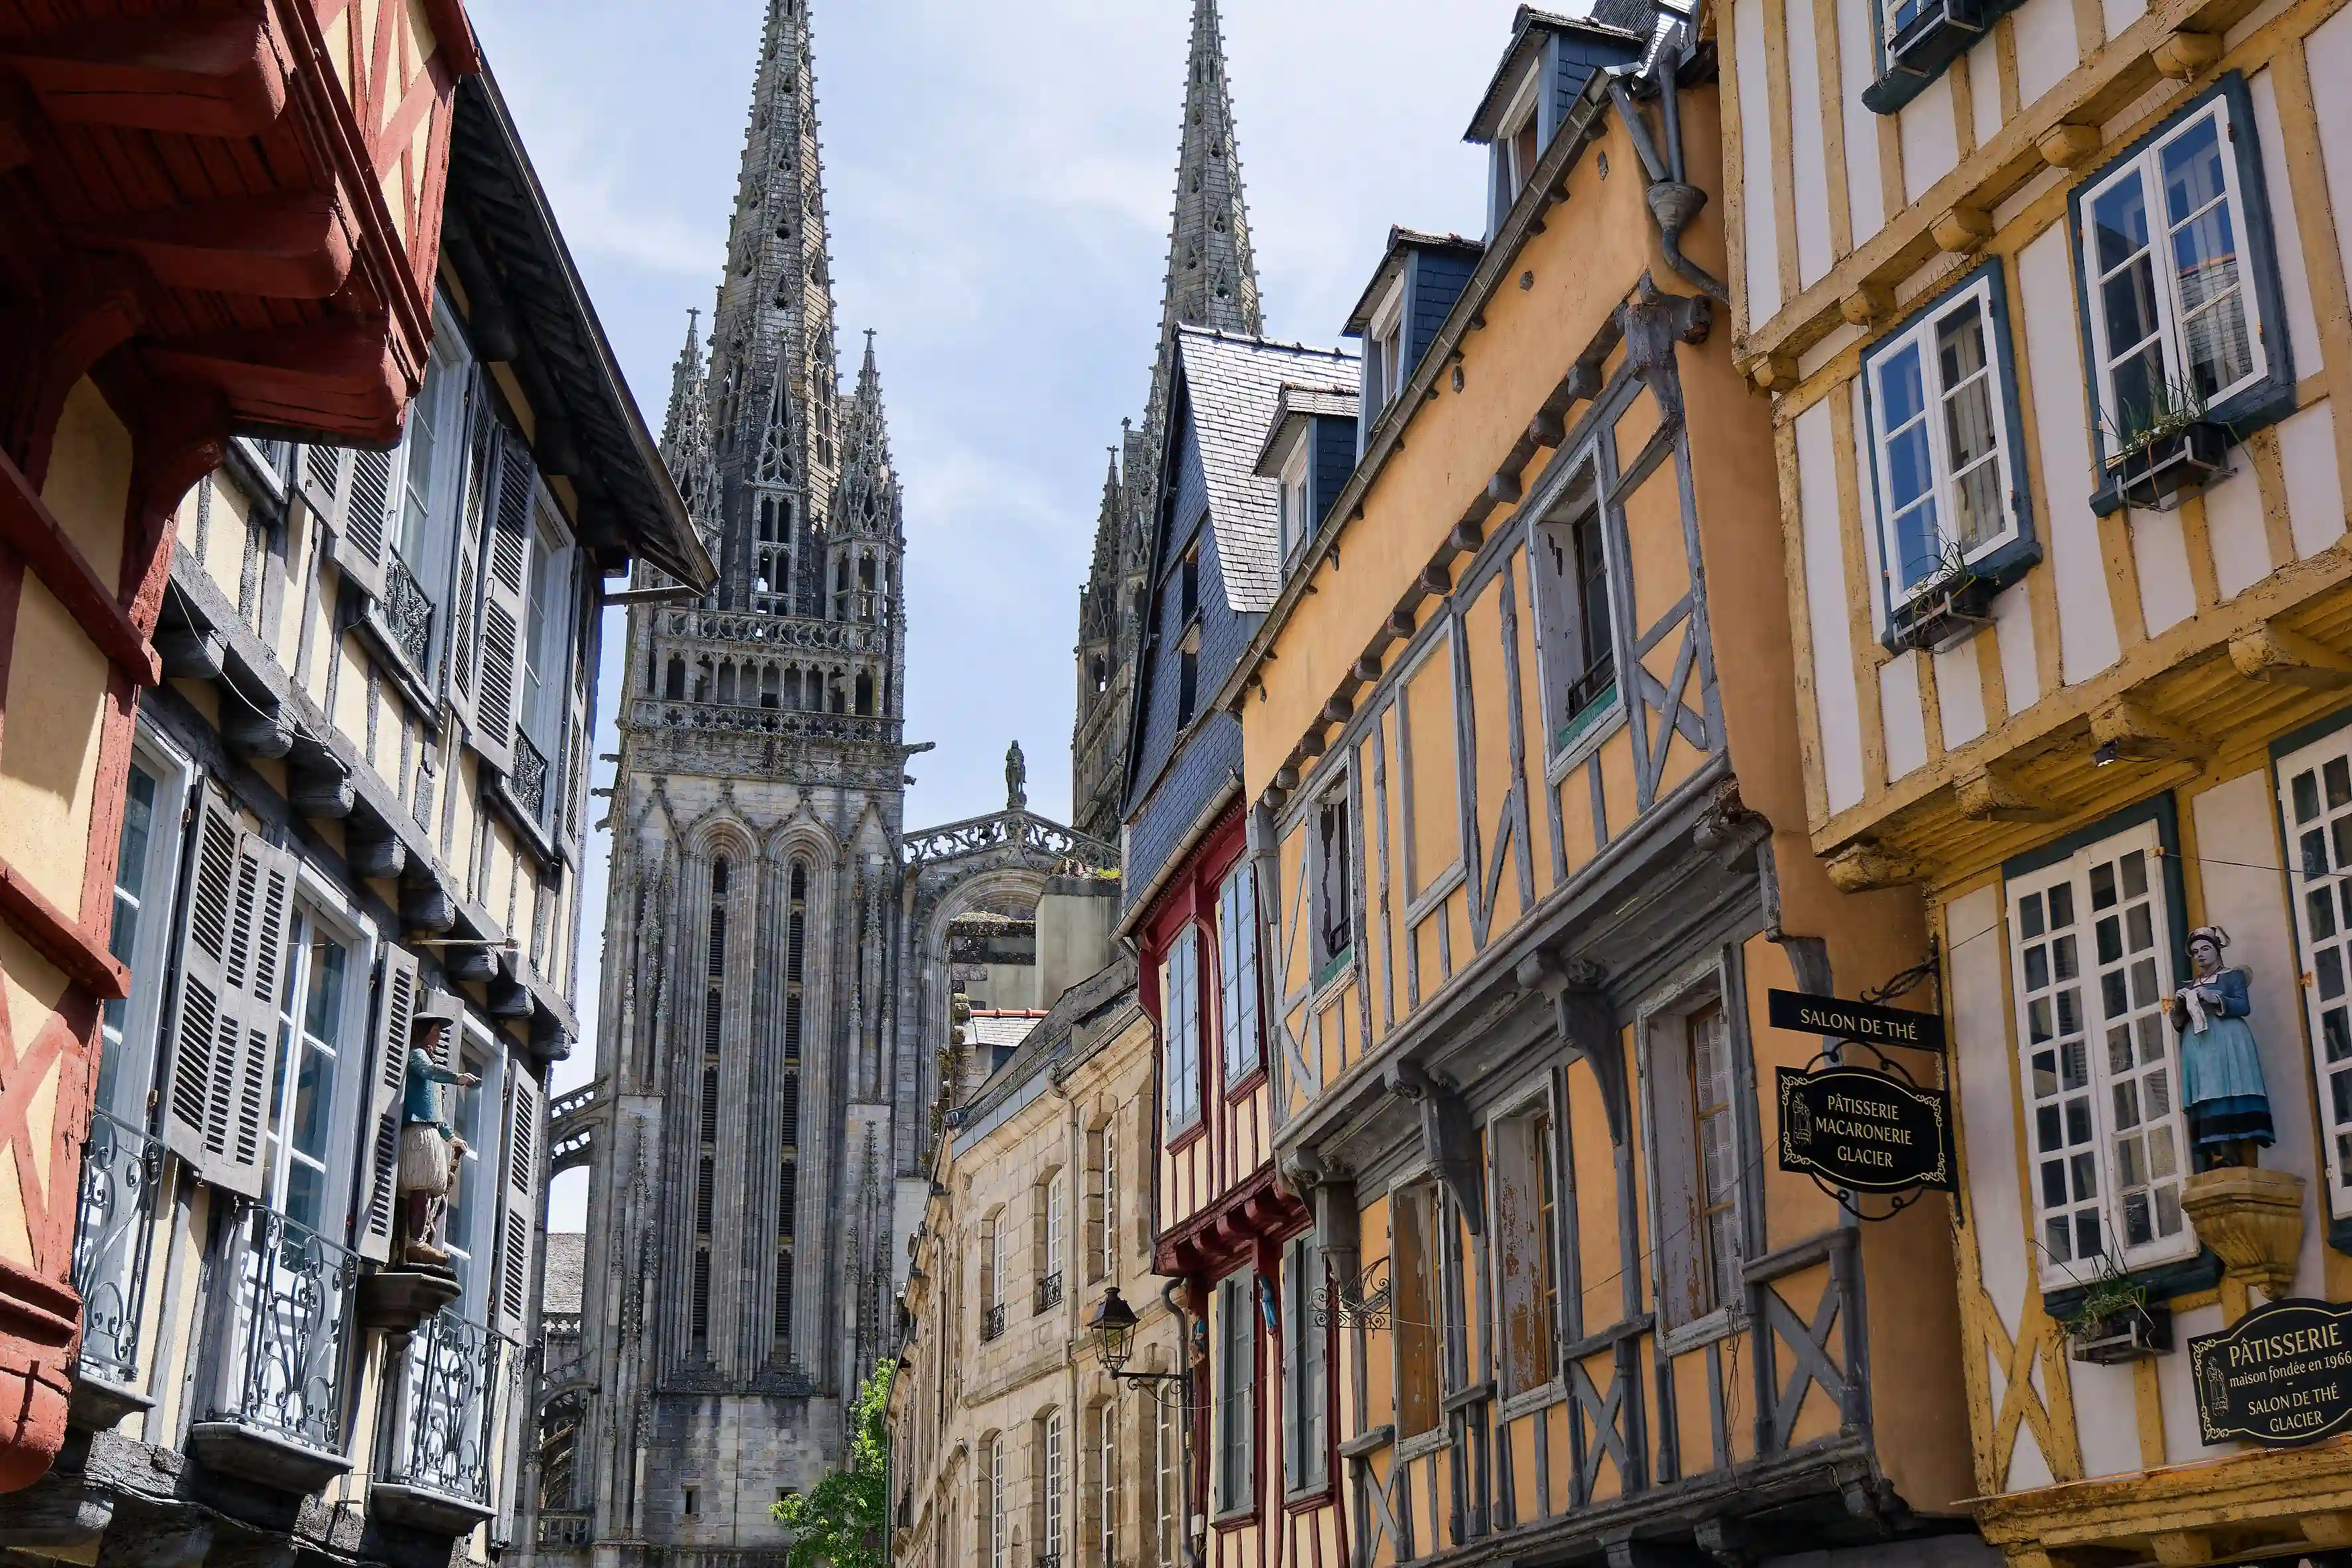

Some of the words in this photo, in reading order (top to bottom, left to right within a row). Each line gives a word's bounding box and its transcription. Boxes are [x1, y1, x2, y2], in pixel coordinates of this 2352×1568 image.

[1800, 1008, 1855, 1031] SALON
[1861, 1018, 1883, 1035] DE
[1885, 1019, 1918, 1040] THÉ
[1827, 1093, 1899, 1120] PÂTISSERIE
[1816, 1117, 1912, 1145] MACARONERIE
[1837, 1146, 1893, 1167] GLACIER
[2229, 1323, 2342, 1367] PÂTISSERIE
[2229, 1370, 2267, 1387] maison
[2268, 1360, 2306, 1382] fondée
[2308, 1360, 2322, 1371] en
[2323, 1351, 2352, 1368] 1966
[2248, 1394, 2290, 1416] SALON
[2292, 1391, 2311, 1407] DE
[2312, 1382, 2339, 1403] THÉ
[2269, 1411, 2324, 1432] GLACIER
